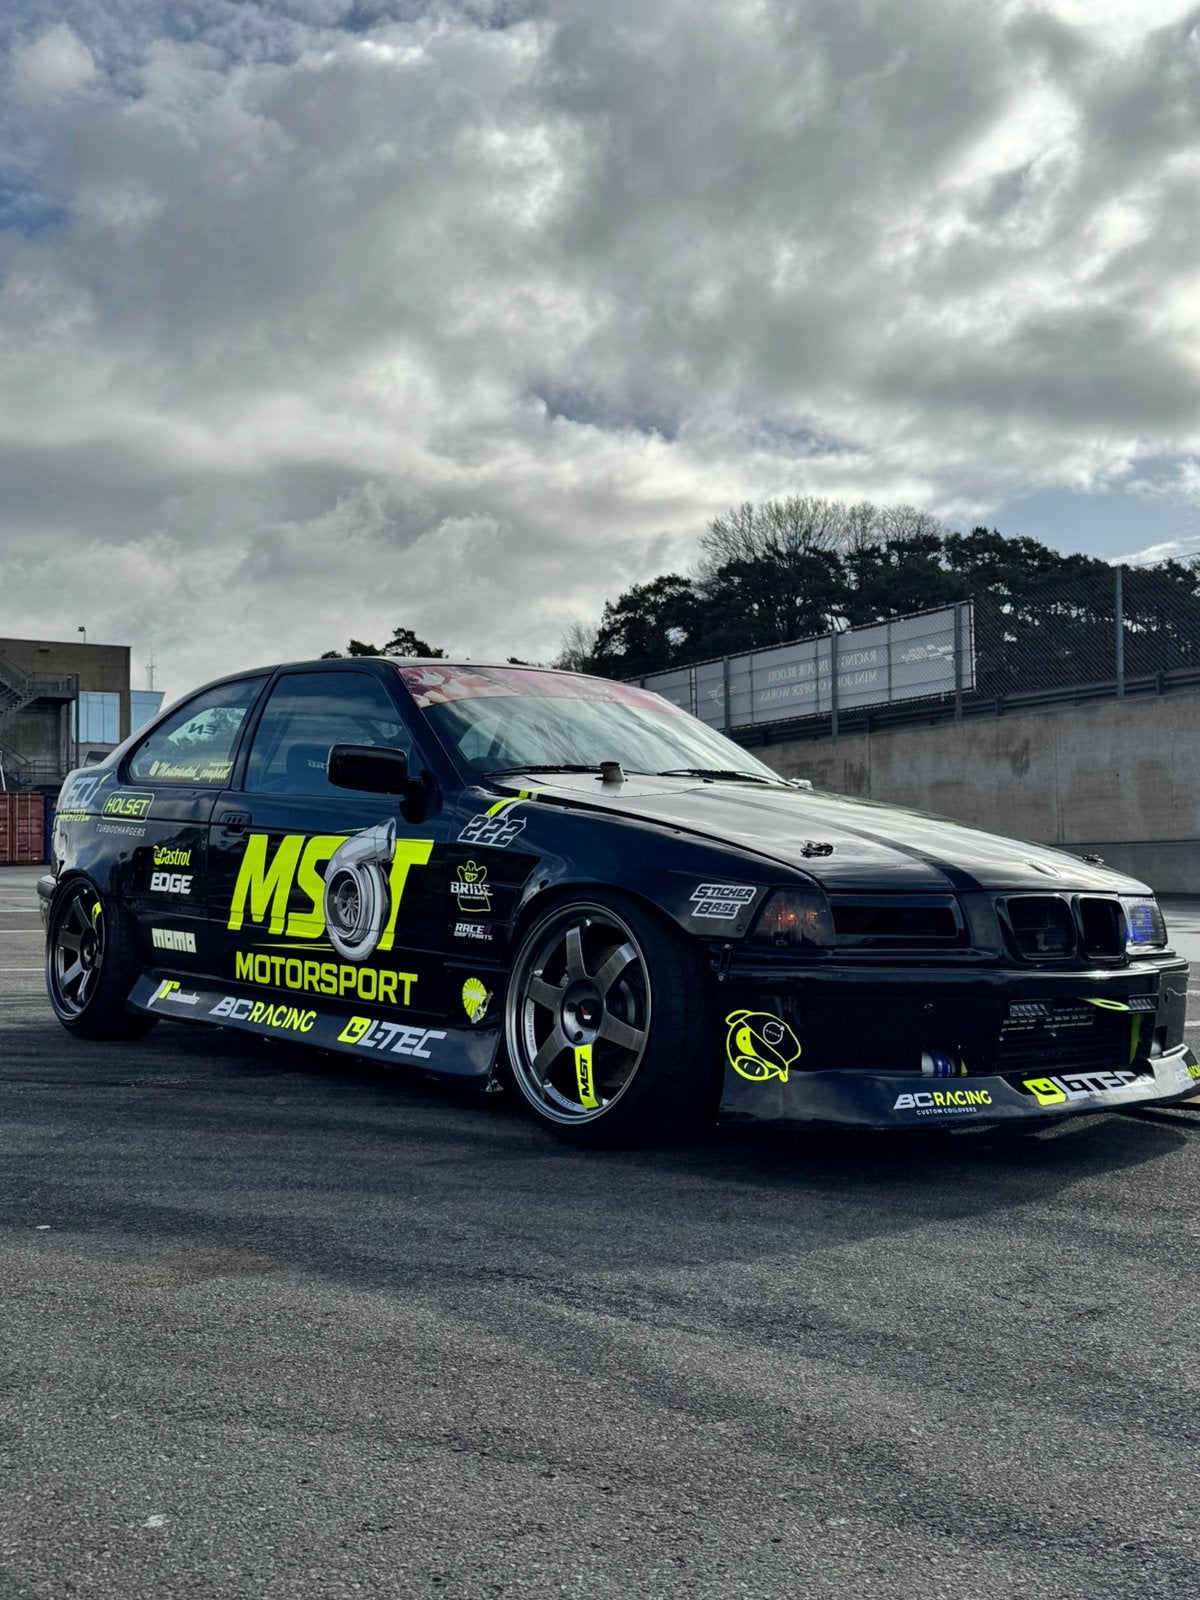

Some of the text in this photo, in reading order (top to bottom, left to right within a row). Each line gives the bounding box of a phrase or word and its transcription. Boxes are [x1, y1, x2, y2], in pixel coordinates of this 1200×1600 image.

[63, 776, 102, 808] ECU
[104, 797, 150, 816] HOLSET
[96, 823, 146, 838] TURBOCHARGERS
[457, 814, 527, 848] 222
[159, 846, 192, 866] Castrol
[150, 872, 193, 895] EDGE
[227, 834, 435, 951] MST
[450, 881, 494, 896] BRIDE
[699, 902, 740, 916] BASE
[235, 950, 419, 1006] MOTORSPORT
[578, 1054, 591, 1098] MST
[916, 1108, 943, 1116] CUSTOM
